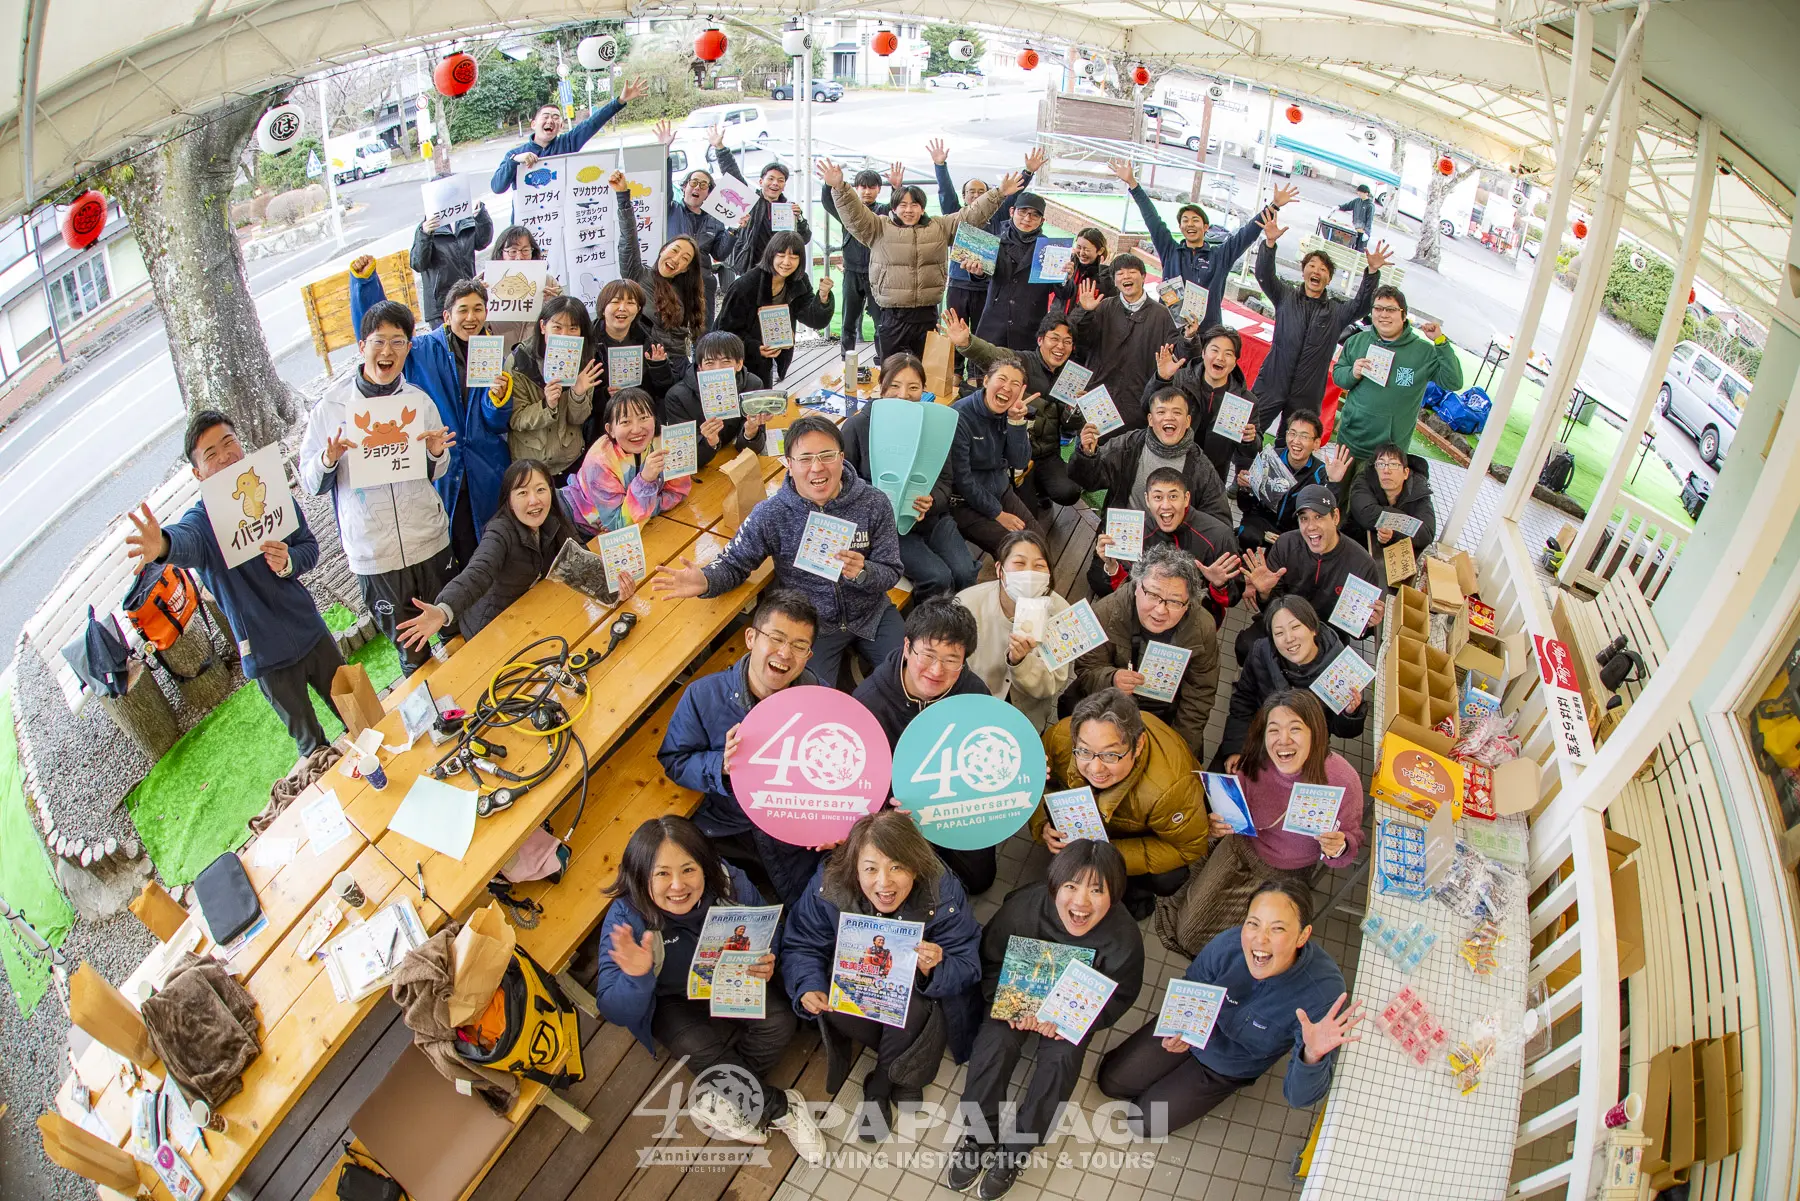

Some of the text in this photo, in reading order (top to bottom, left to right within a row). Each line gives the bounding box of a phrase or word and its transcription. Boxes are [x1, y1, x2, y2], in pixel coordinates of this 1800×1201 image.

[573, 185, 609, 197] マツカサウオ
[522, 211, 559, 226] アオヤガラ
[576, 251, 606, 263] ガンガゼ
[489, 299, 533, 312] カワハギ
[363, 443, 409, 460] ショウジン
[391, 457, 410, 471] ガニ
[231, 506, 284, 551] イバラタツ
[814, 518, 848, 532] BINGYO
[1152, 647, 1183, 660] BINGYO
[1300, 787, 1335, 797] BINGYO
[764, 794, 854, 809] Anniversary
[932, 797, 1017, 818] Anniversary
[1052, 795, 1085, 806] BINGYO
[767, 810, 818, 821] PAPALAGI
[936, 816, 986, 831] PAPALAGI
[989, 812, 1006, 821] SINCE
[1007, 970, 1022, 980] The
[1025, 974, 1047, 984] Coral
[1072, 968, 1106, 991] BINGYO
[1176, 985, 1215, 998] BINGYO
